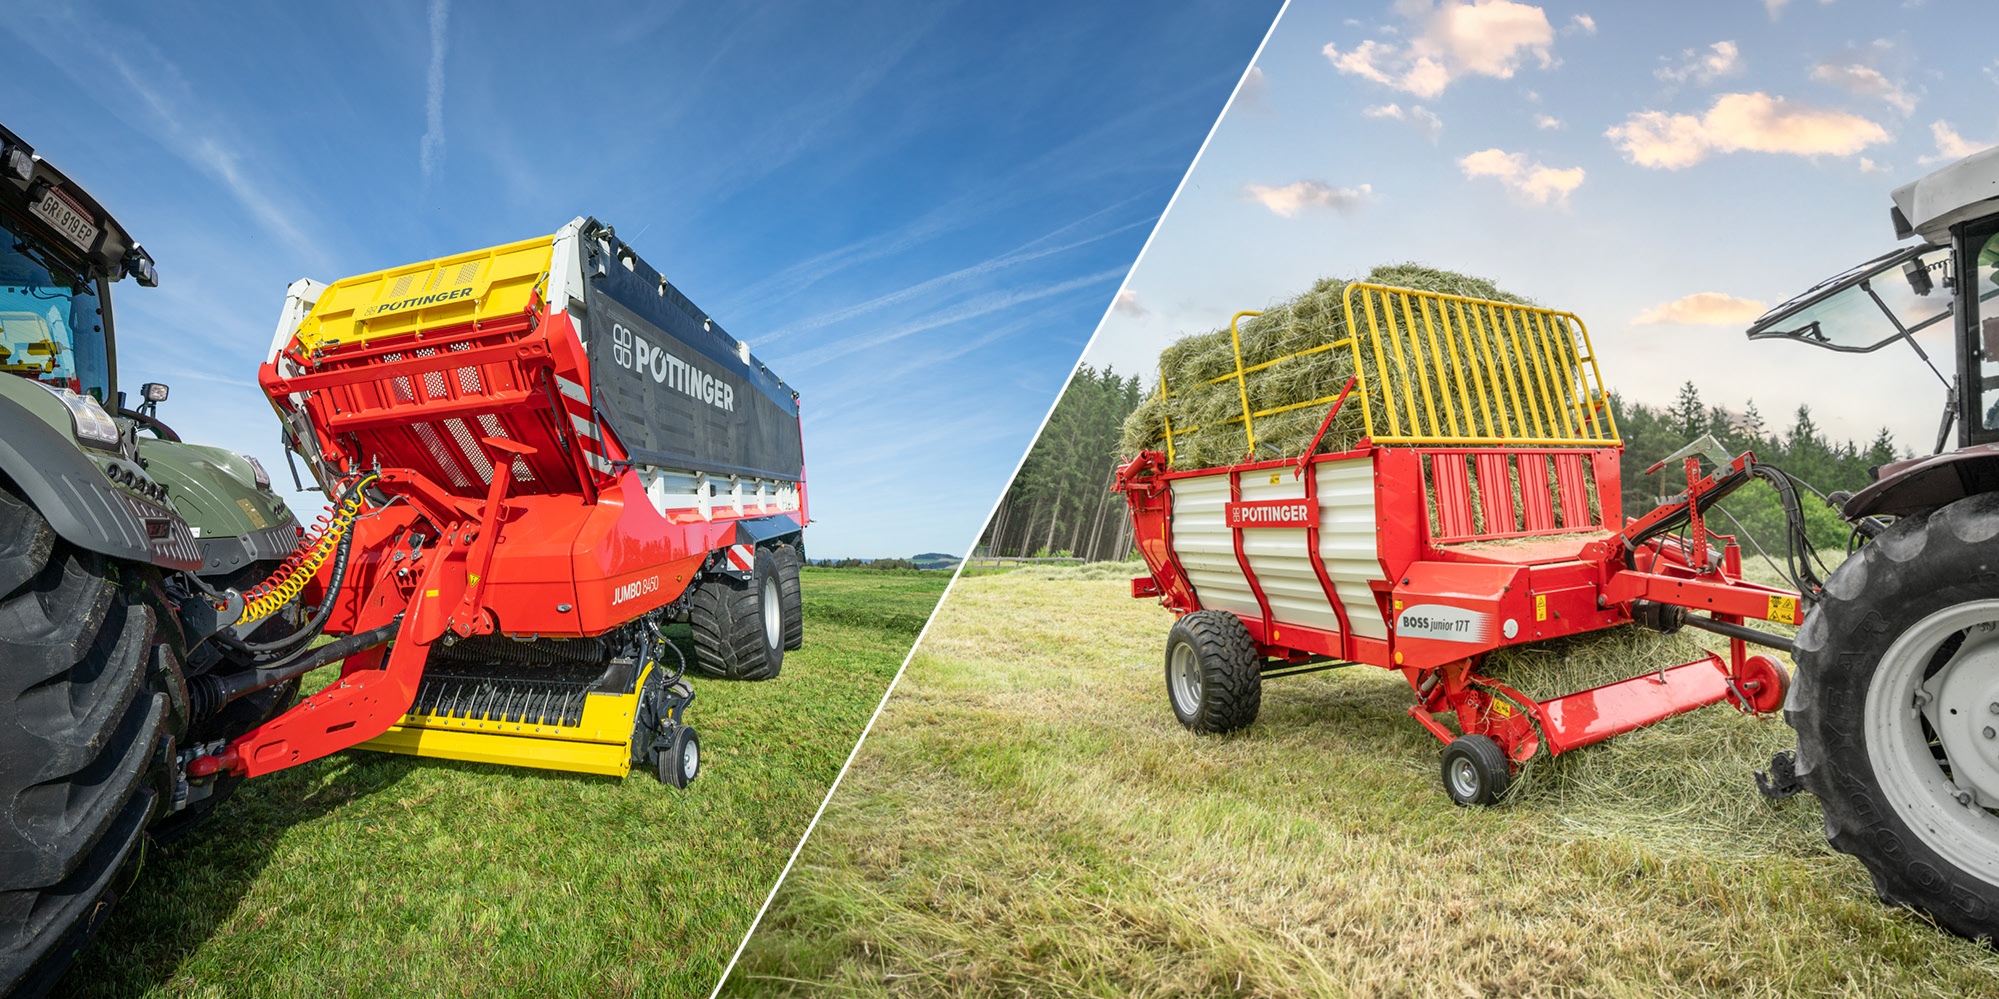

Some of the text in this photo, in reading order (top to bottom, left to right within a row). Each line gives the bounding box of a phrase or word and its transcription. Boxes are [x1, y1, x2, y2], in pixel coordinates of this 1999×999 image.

[42, 196, 93, 241] GR 919 EP
[612, 575, 659, 605] JUMBO 8450
[1403, 616, 1470, 632] BOSS junior 17T
